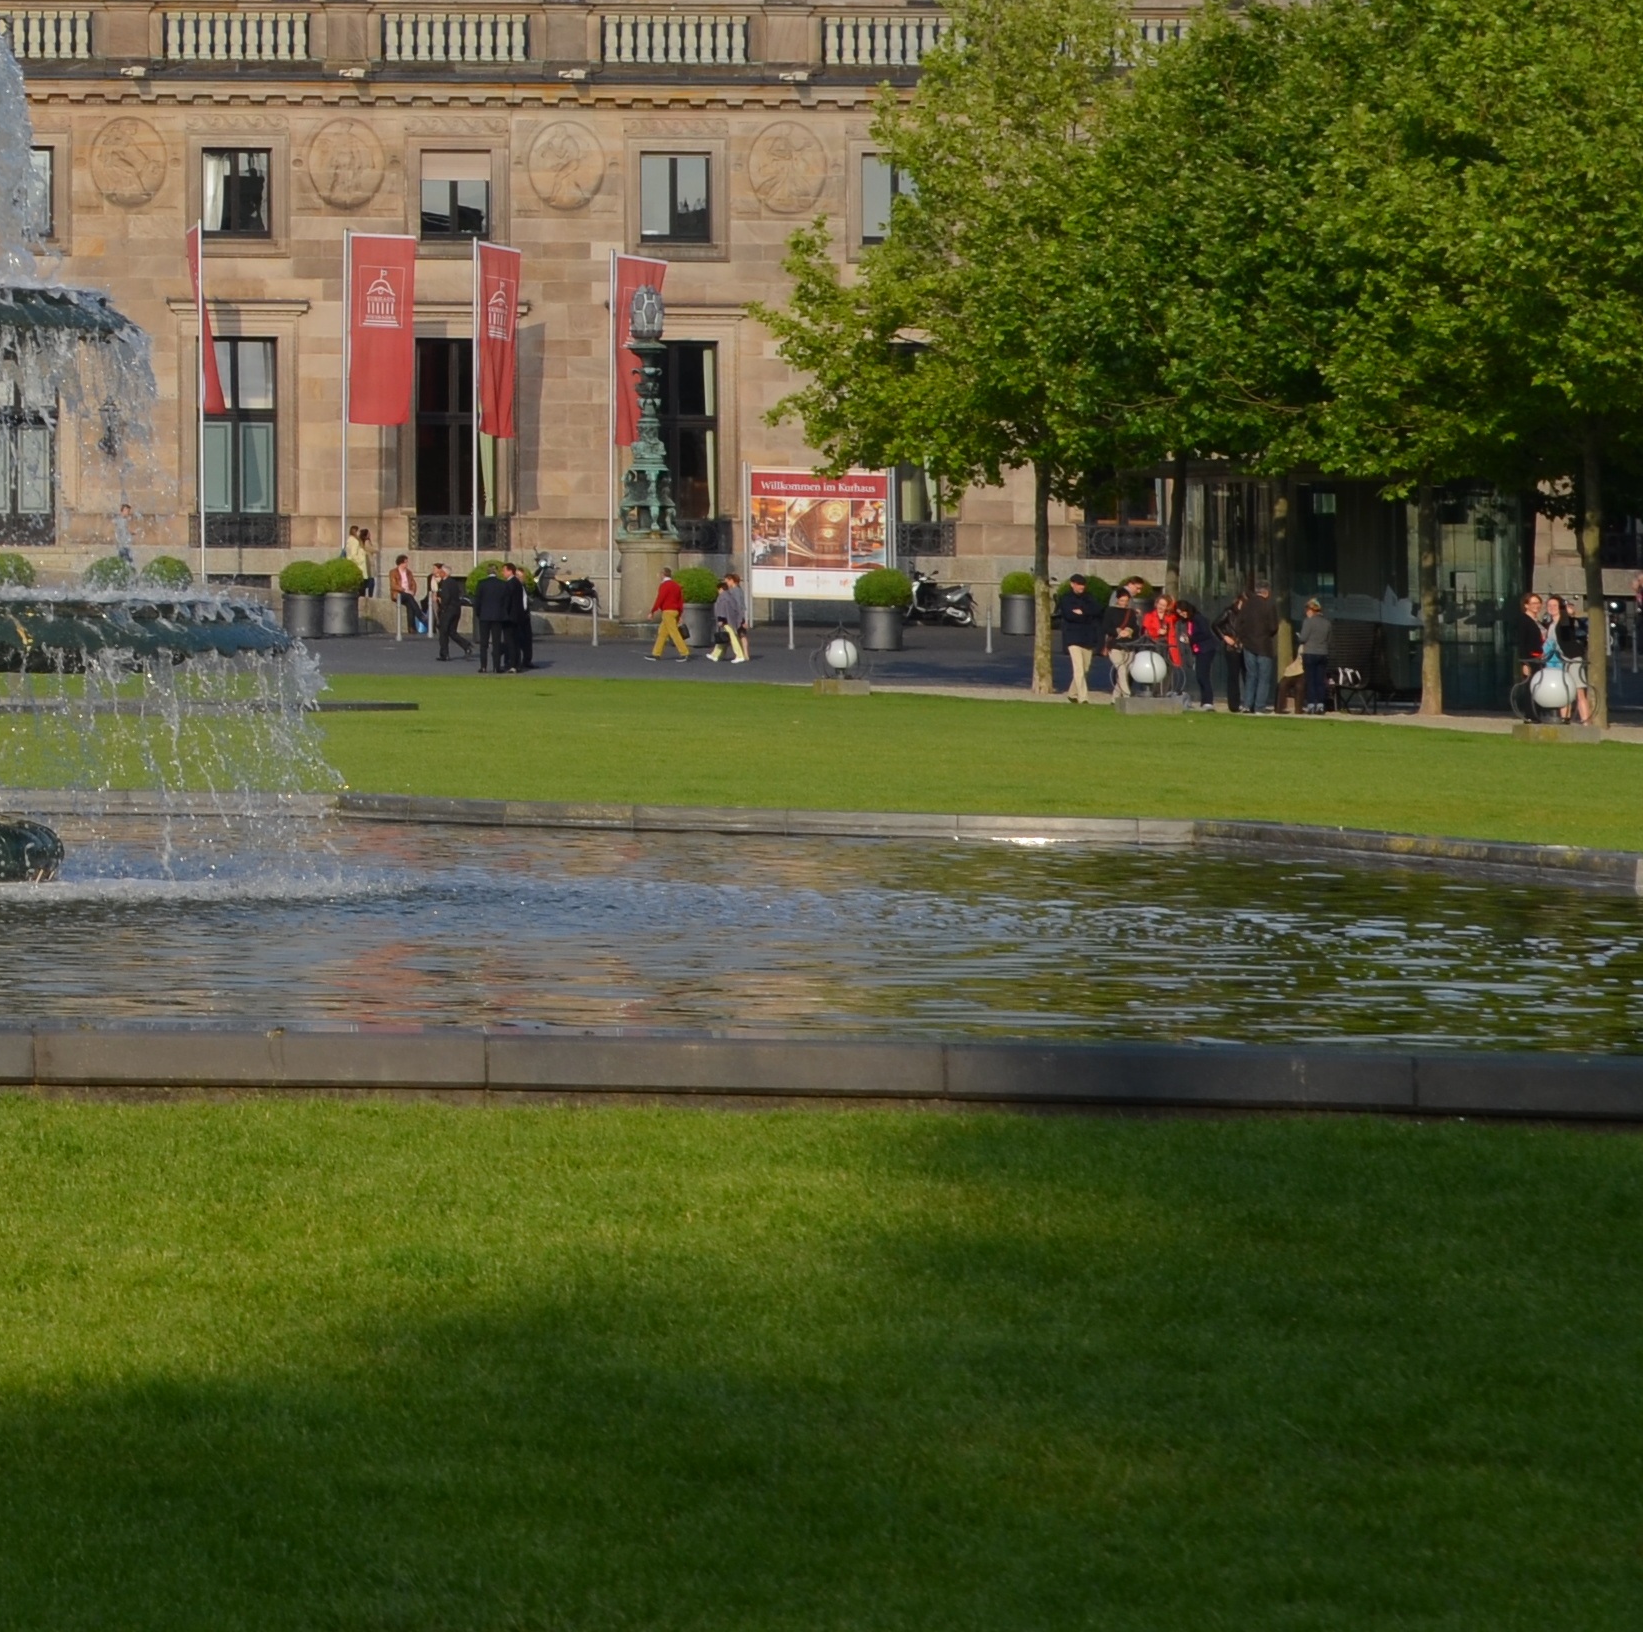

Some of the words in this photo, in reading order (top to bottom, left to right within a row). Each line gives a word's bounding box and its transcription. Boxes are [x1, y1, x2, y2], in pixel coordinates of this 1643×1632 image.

[760, 480, 821, 492] Willkommen
[823, 483, 836, 492] im
[838, 483, 876, 493] Kurhaus
